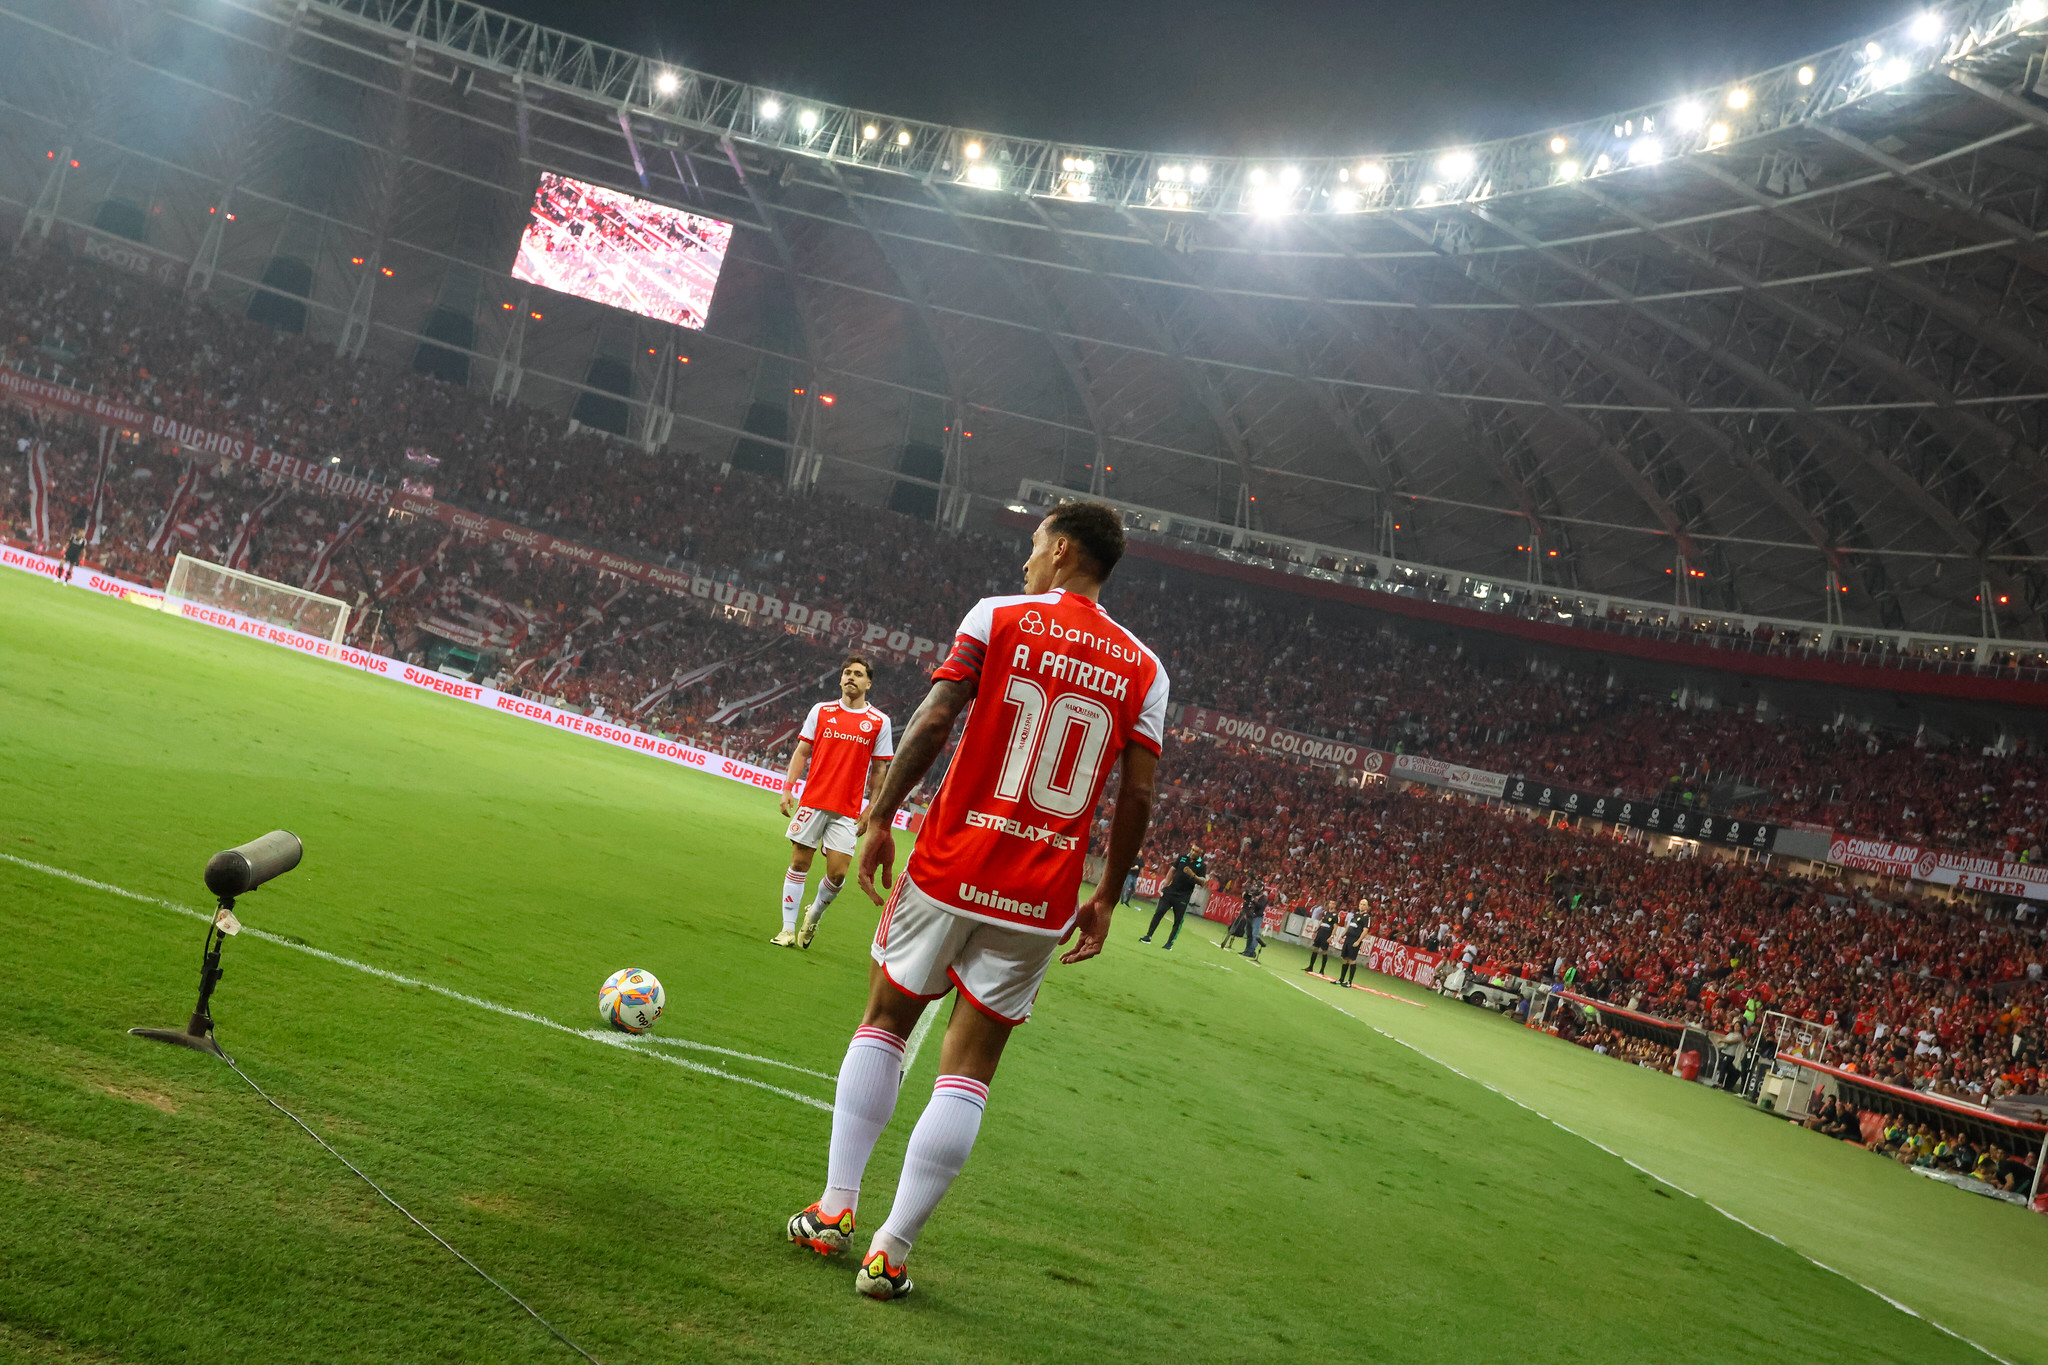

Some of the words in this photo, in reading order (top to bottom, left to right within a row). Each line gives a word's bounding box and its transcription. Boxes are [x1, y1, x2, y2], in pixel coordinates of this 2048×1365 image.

[152, 414, 245, 460] GAUCHOS
[249, 446, 264, 466] E
[267, 451, 394, 506] PELEADORES
[402, 498, 434, 517] Claro
[452, 513, 484, 531] Claro
[502, 528, 533, 545] Claro
[3, 551, 24, 567] EM
[549, 540, 593, 561] PanVel
[599, 554, 642, 576] PanVel
[648, 568, 689, 589] PanVel
[690, 576, 834, 631] GUARDA
[181, 603, 236, 629] RECEBA
[239, 620, 267, 637] ATÉ
[268, 628, 315, 651] R$500
[341, 649, 388, 673] BÔNUS
[1050, 618, 1142, 667] banrisul
[403, 667, 483, 701] SUPERBET
[1012, 643, 1031, 672] A.
[1038, 651, 1130, 702] PATRICK
[497, 696, 552, 722] RECEBA
[555, 713, 583, 730] ATÉ
[584, 722, 632, 744] R$500
[633, 736, 656, 752] EM
[657, 743, 707, 766] BÔNUS
[833, 729, 871, 746] banrisul
[993, 674, 1113, 820] 10
[1270, 731, 1358, 766] COLORADO
[721, 761, 803, 795] SUPERBT
[796, 809, 813, 824] 27
[1846, 838, 1919, 862] CONSULADO
[1938, 852, 1999, 877] SALDANHA
[1973, 876, 2026, 897] INTER
[958, 882, 1049, 920] Unimed
